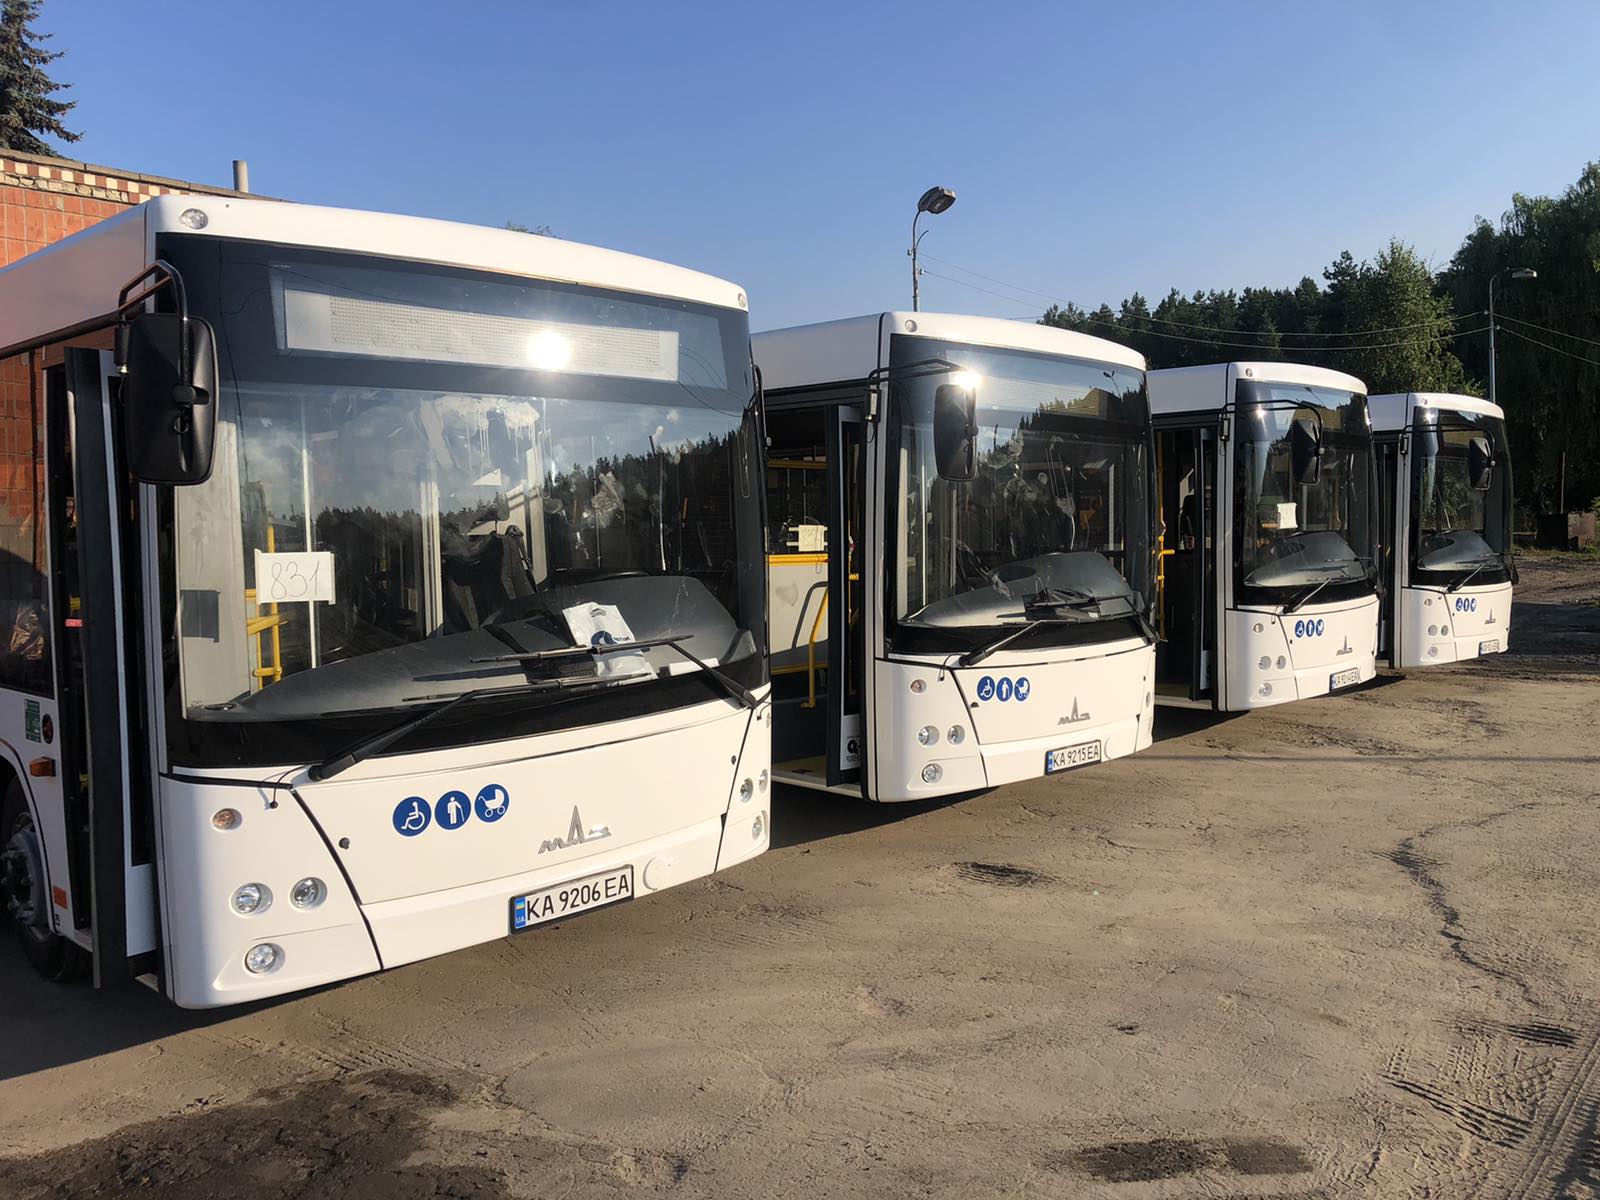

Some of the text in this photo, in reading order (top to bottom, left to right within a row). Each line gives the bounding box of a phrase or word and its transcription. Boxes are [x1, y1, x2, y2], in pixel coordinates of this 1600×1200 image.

[271, 560, 320, 600] 831
[1068, 747, 1086, 766] 9215
[527, 874, 629, 921] KA 9206 EA
